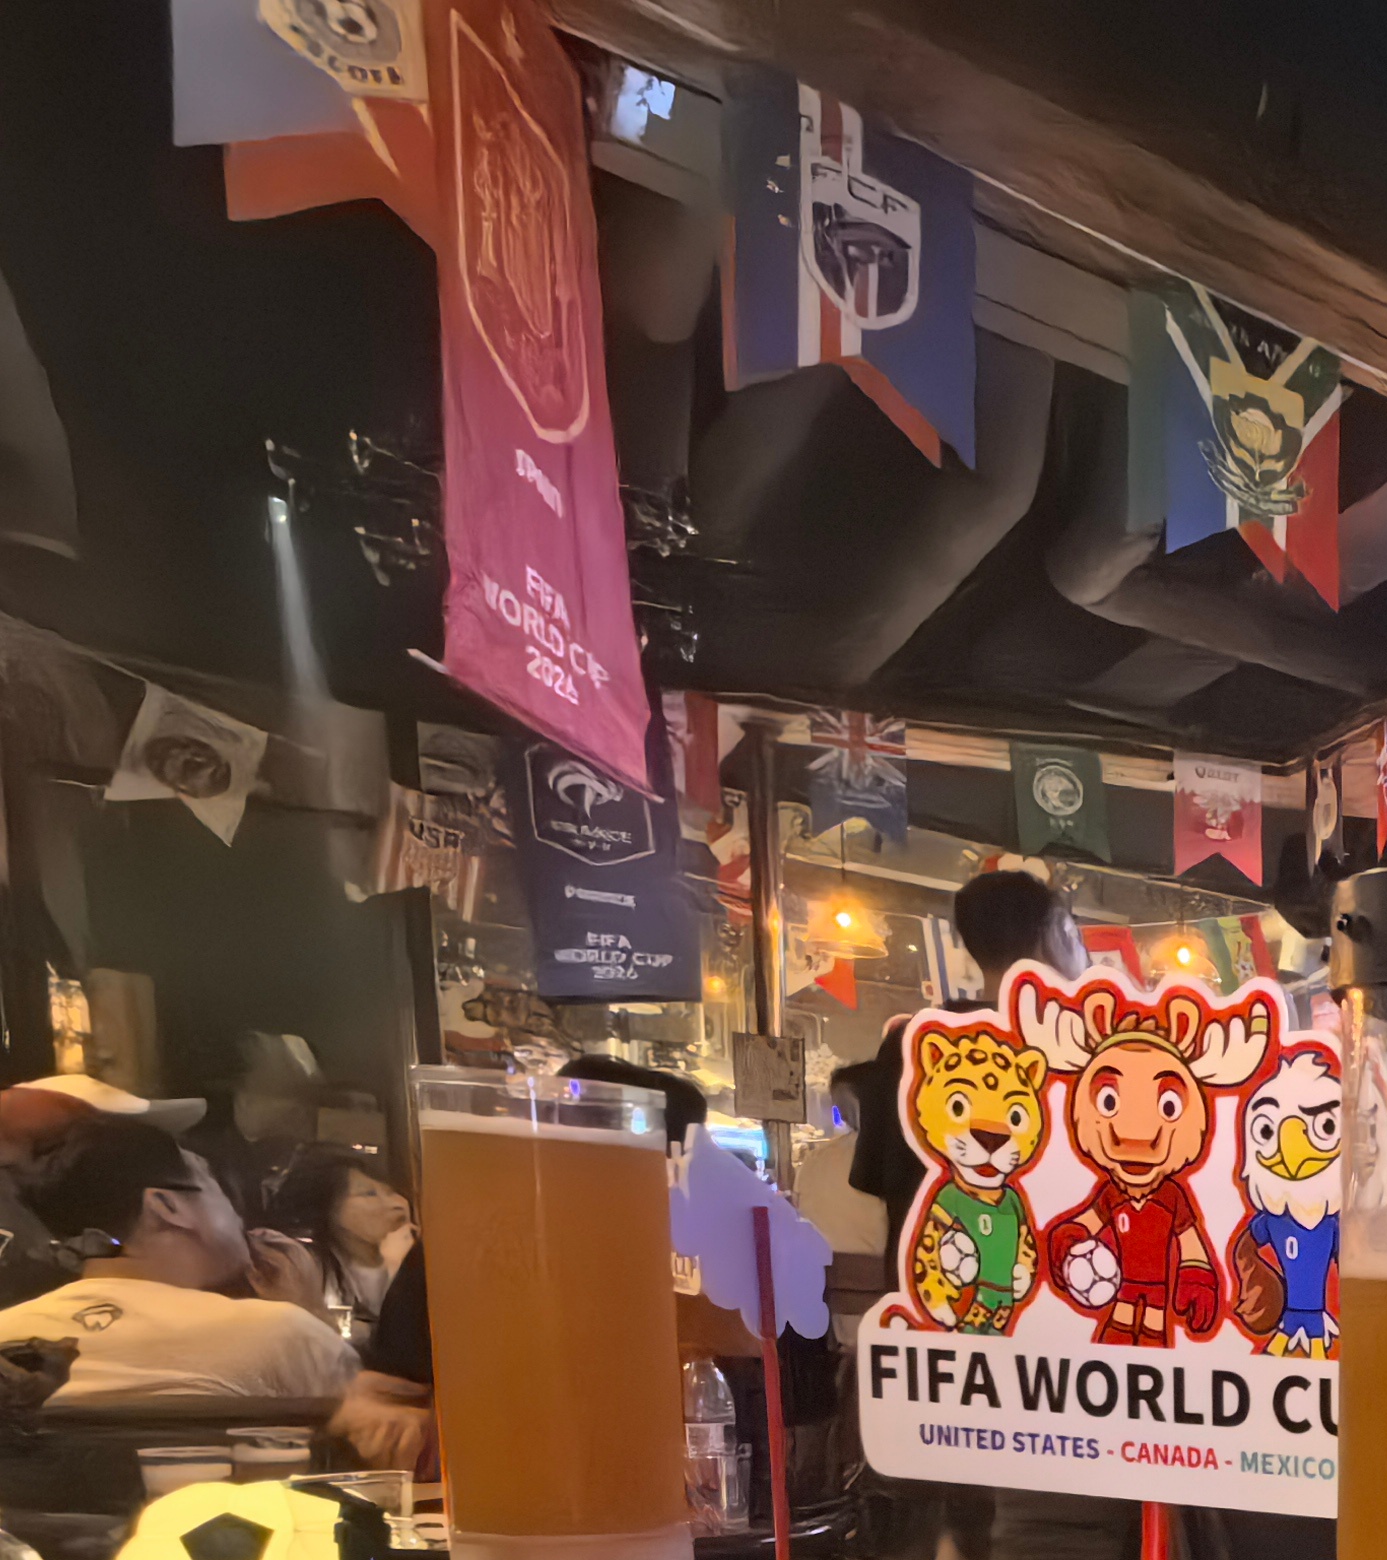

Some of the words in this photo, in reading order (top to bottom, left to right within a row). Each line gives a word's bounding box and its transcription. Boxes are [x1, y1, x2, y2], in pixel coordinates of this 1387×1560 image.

[870, 1344, 1003, 1409] FIFA
[1014, 1354, 1251, 1428] WORLD
[1272, 1374, 1340, 1436] CU
[919, 1422, 1006, 1453] UNITED
[1012, 1431, 1101, 1460] STATES
[1120, 1440, 1220, 1471] CANADA
[1240, 1450, 1336, 1481] MEXICO
